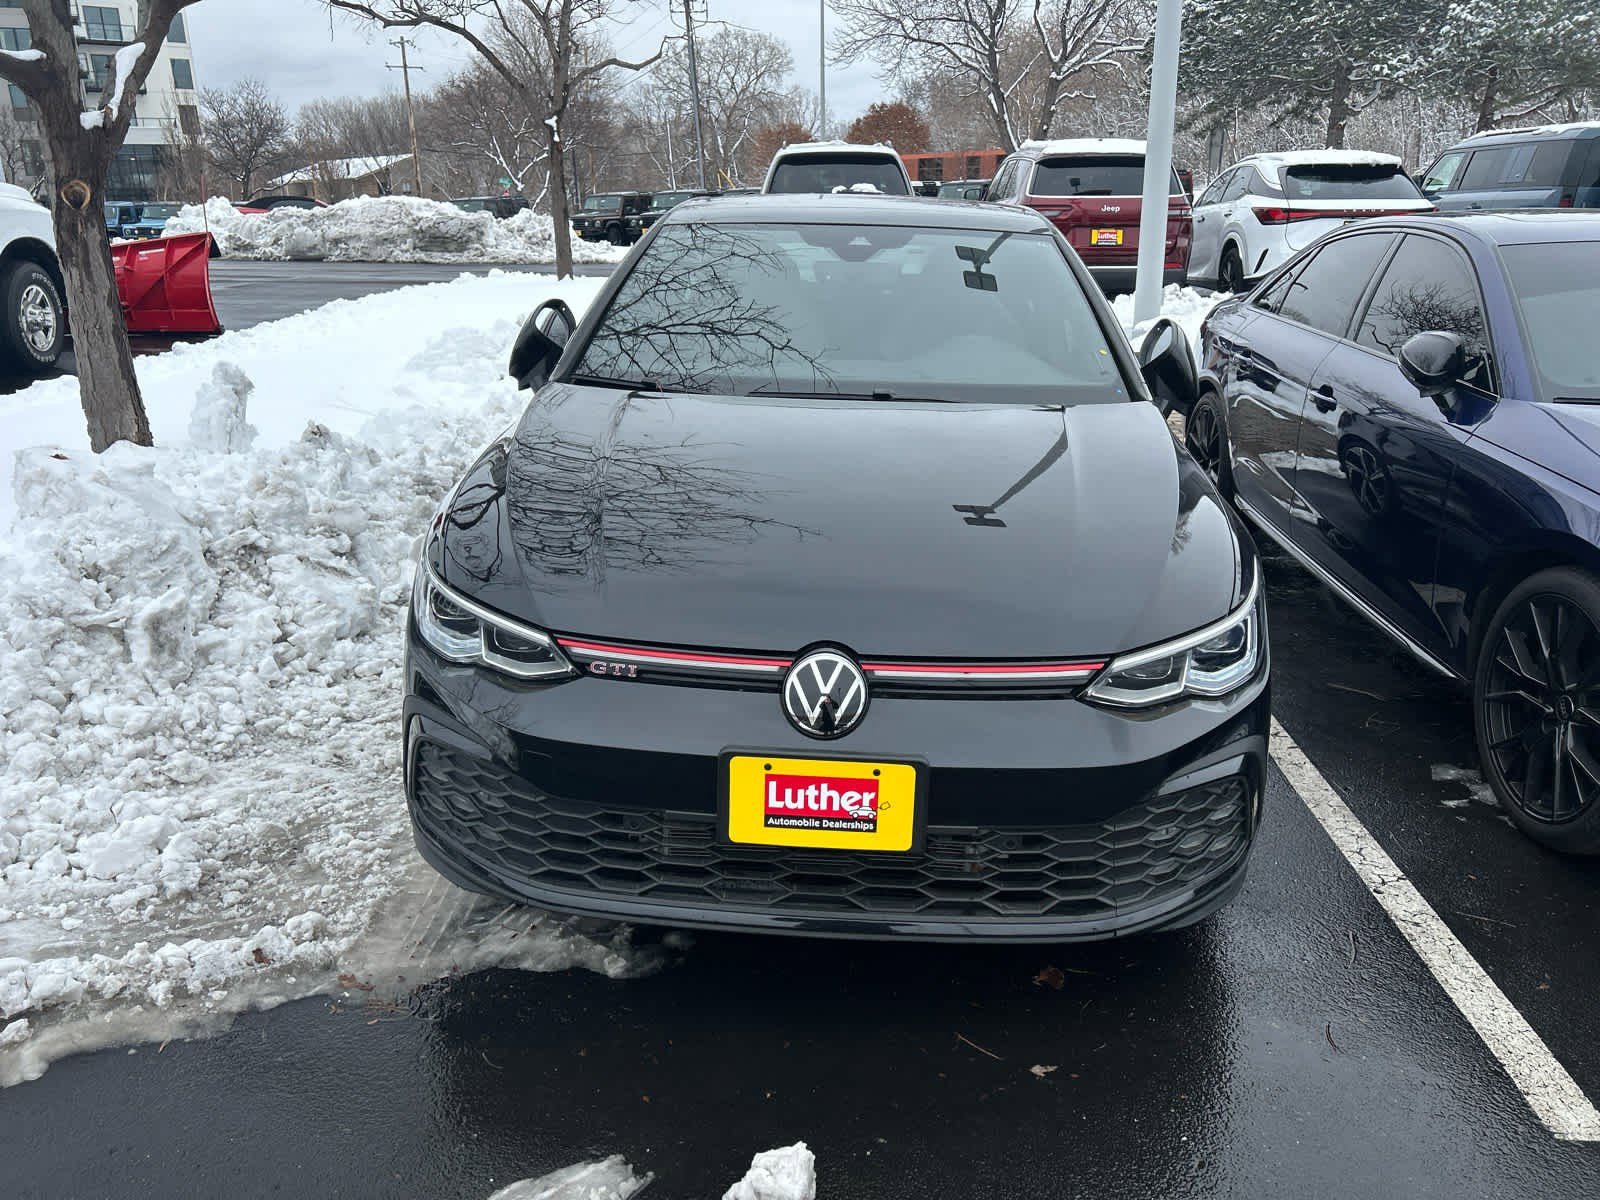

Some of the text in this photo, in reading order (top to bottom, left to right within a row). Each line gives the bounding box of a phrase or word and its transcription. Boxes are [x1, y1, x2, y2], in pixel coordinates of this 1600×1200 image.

[1101, 205, 1121, 213] Jeep
[590, 661, 638, 678] GTI
[768, 781, 876, 812] Luther
[767, 817, 875, 831] Automobile Dealerships
